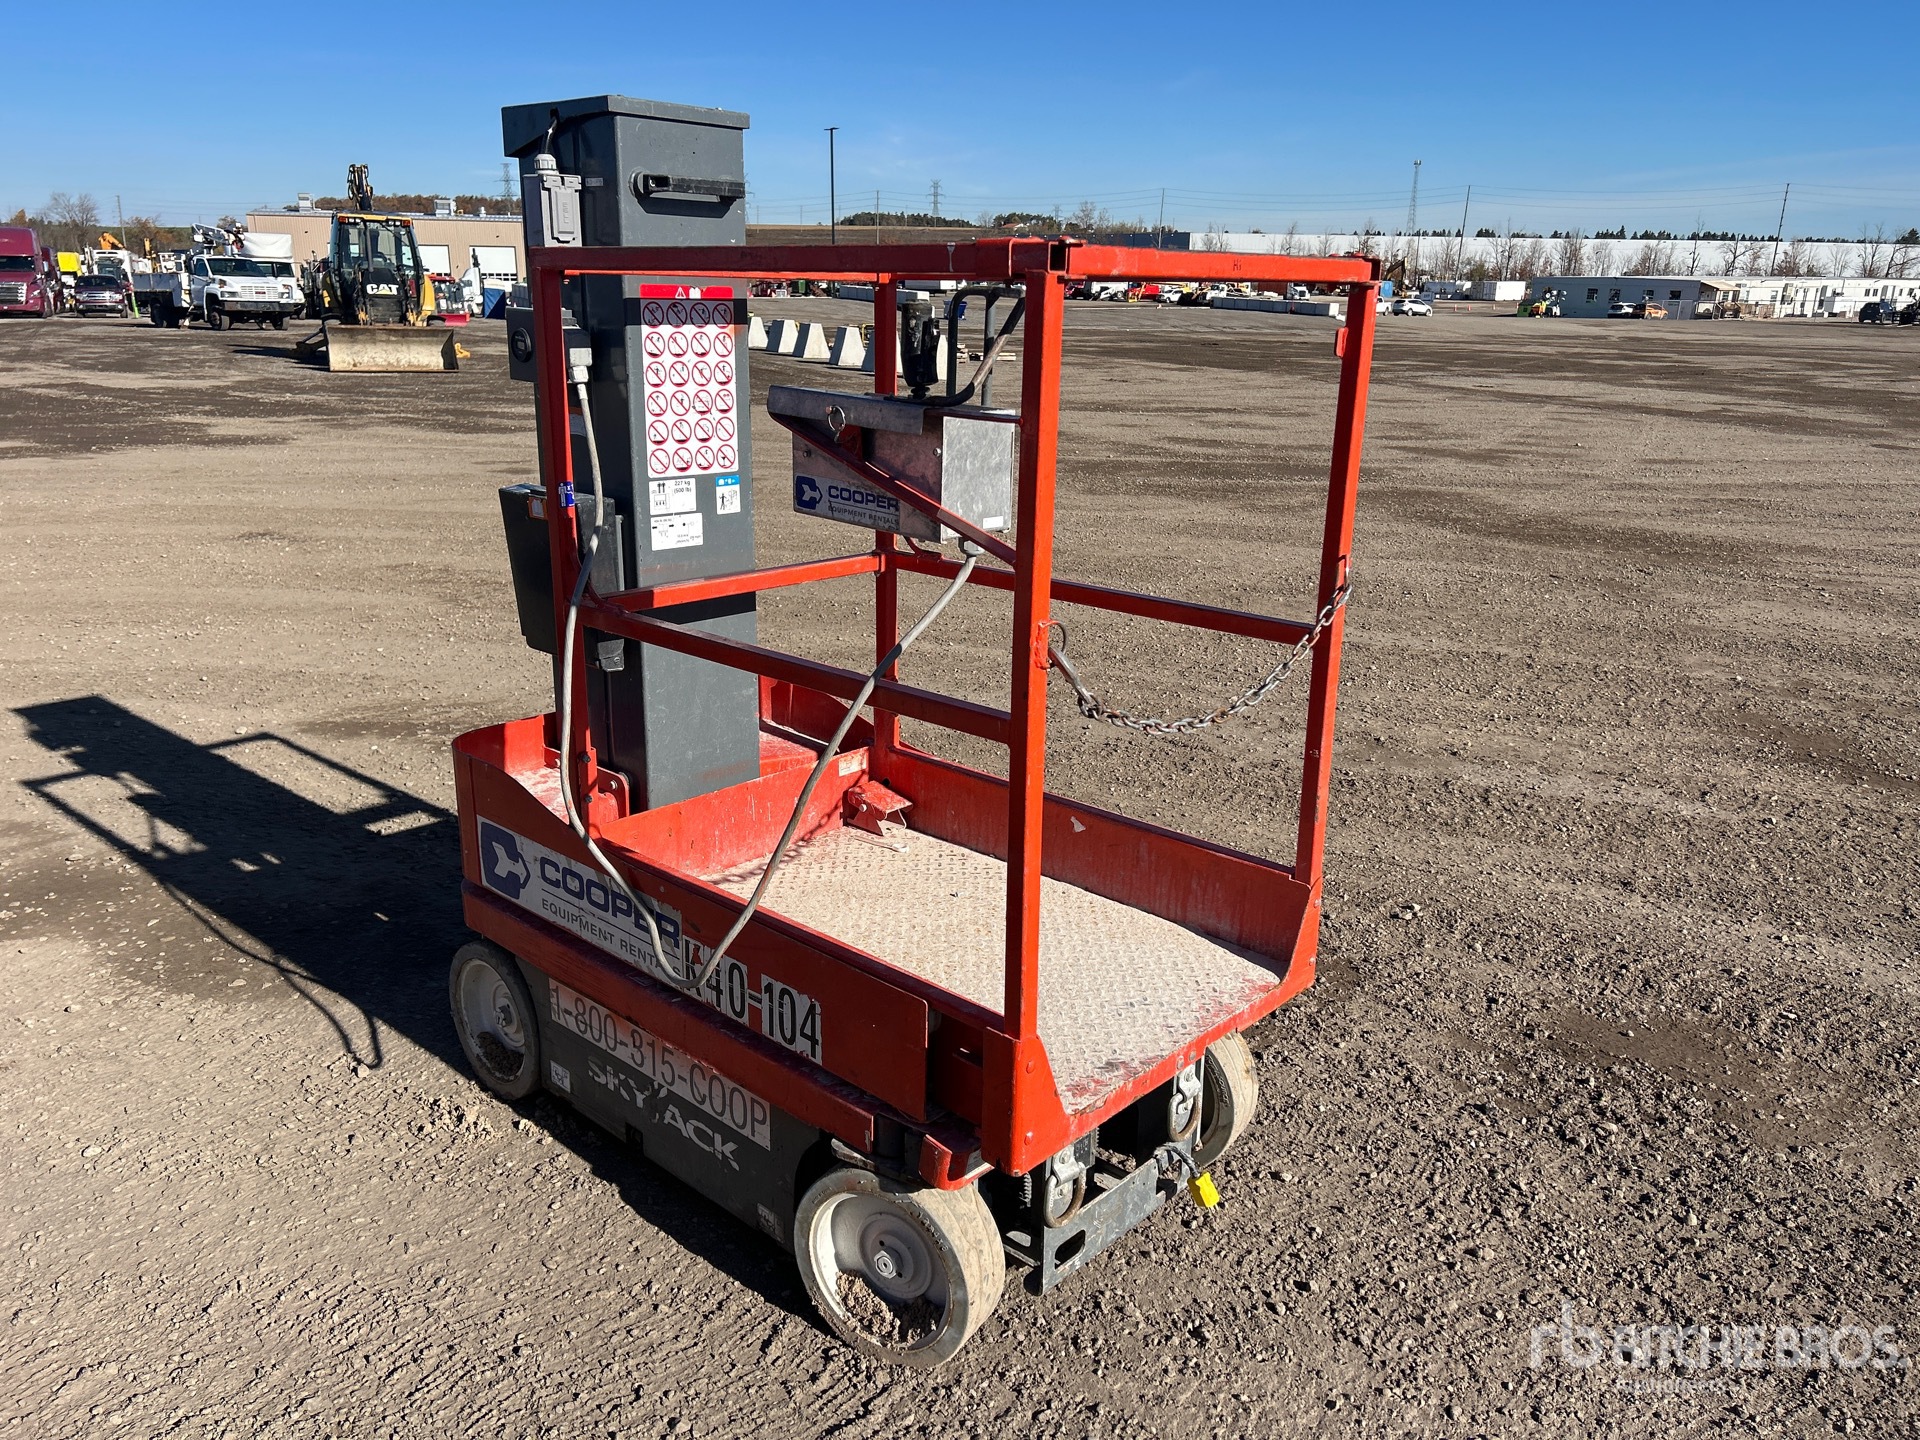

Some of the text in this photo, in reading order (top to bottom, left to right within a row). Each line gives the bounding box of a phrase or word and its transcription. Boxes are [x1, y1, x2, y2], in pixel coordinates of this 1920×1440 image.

[366, 283, 399, 295] CAT
[828, 485, 900, 511] COOPER
[828, 505, 867, 518] EQUIPMENT
[539, 857, 681, 949] COOPER
[541, 898, 682, 978] EQUIPMENT RENTS
[587, 1056, 740, 1171] SKYACK
